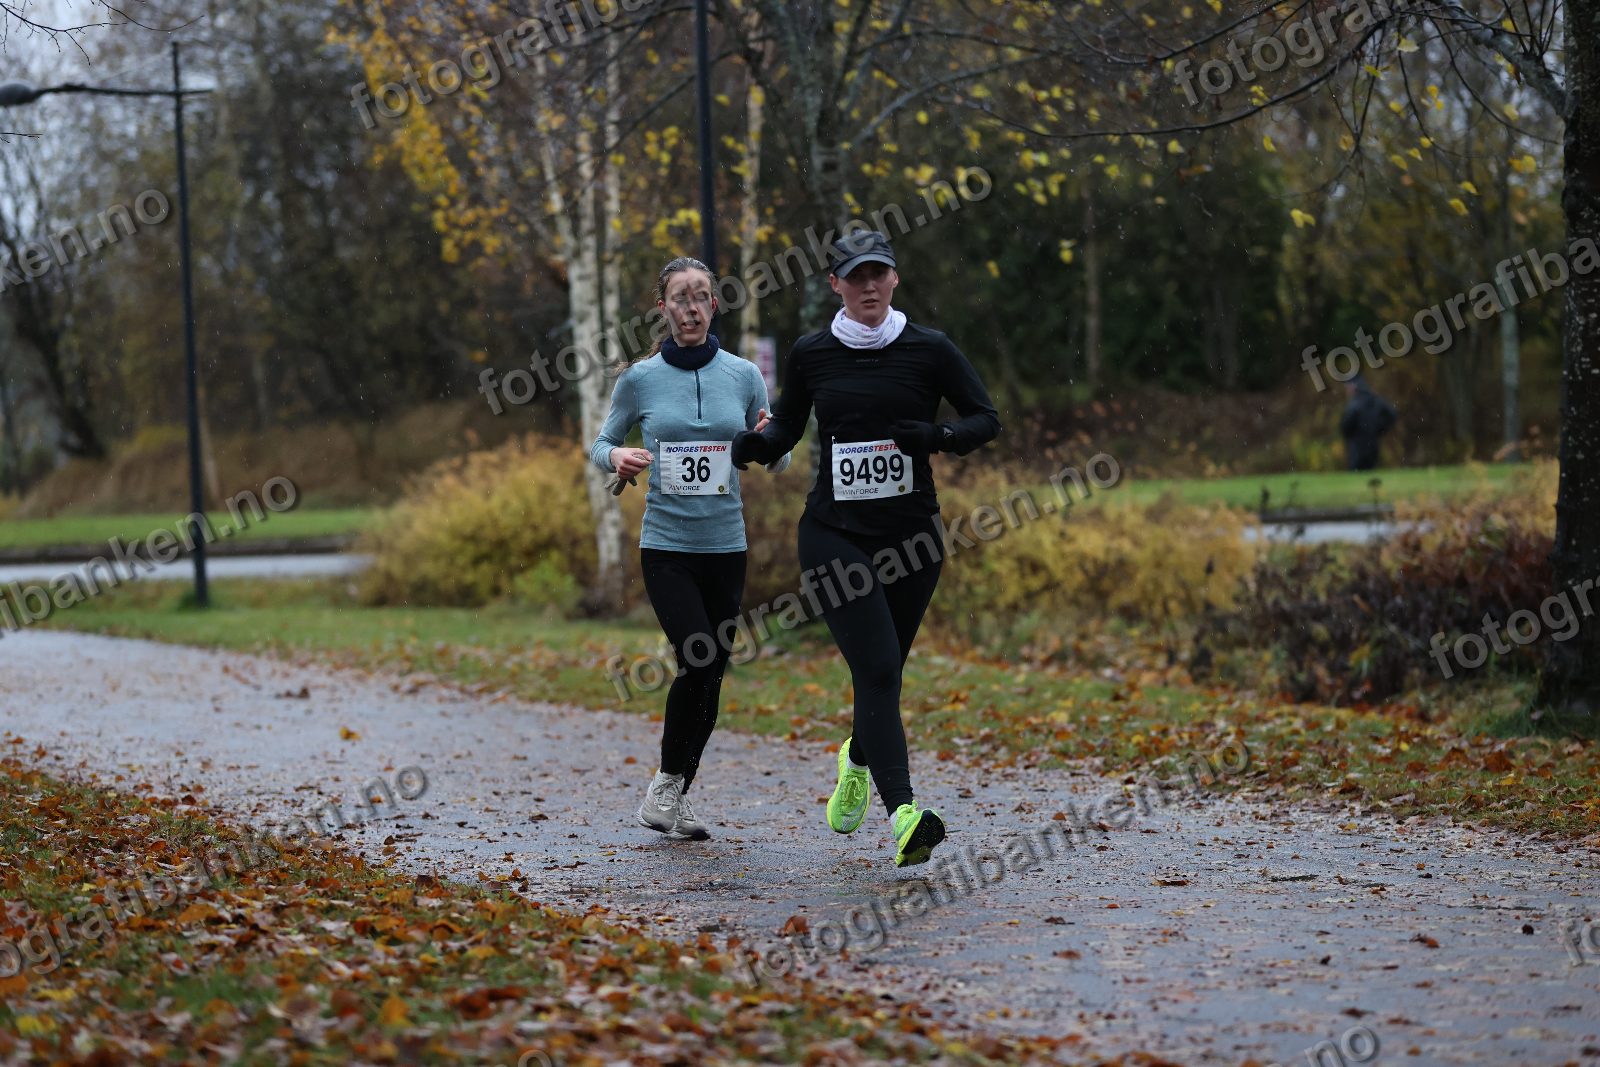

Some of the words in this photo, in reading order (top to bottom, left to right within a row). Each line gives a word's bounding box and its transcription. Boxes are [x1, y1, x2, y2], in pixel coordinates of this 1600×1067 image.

[666, 445, 727, 453] NORGESTESTEN
[839, 443, 898, 455] NORGESTESTE
[681, 456, 711, 483] 36
[839, 453, 905, 486] 9499
